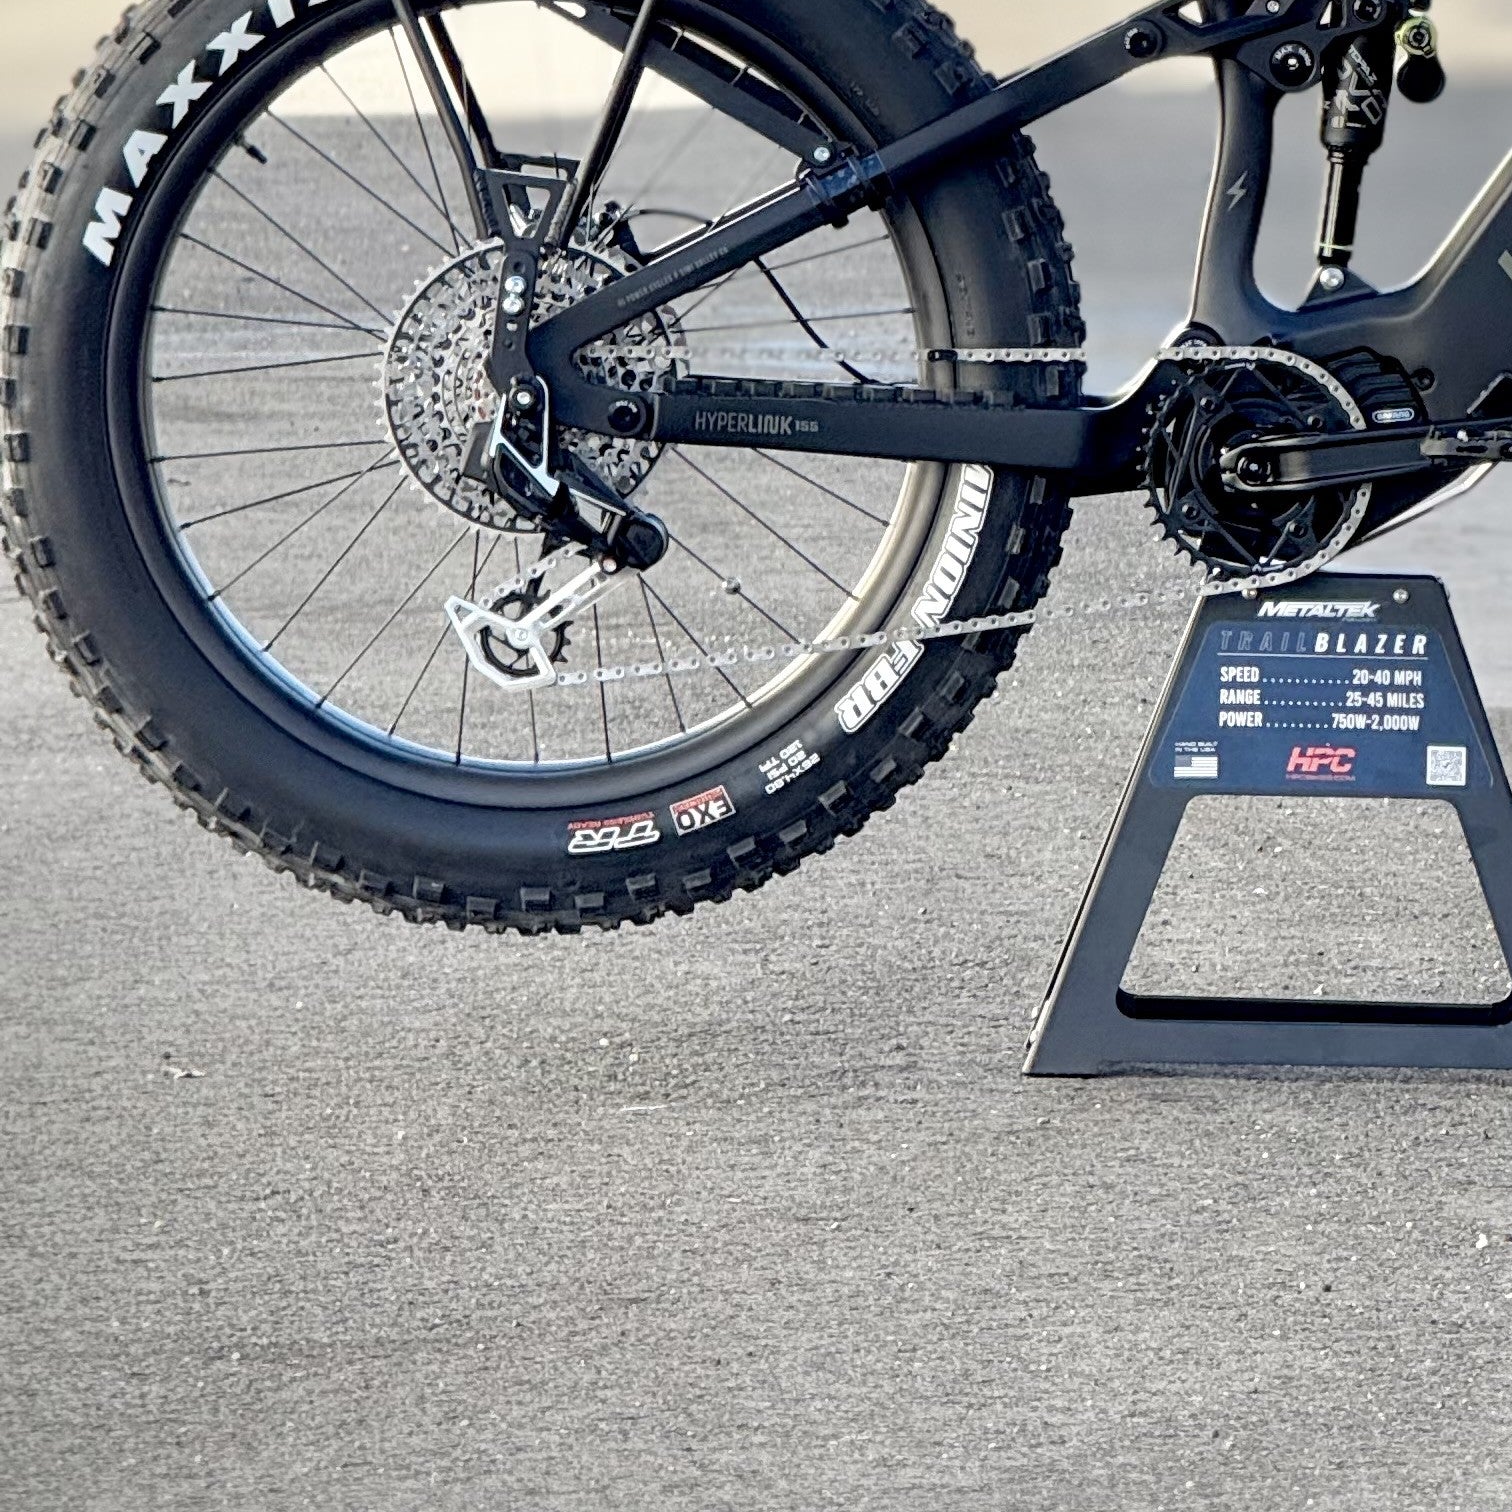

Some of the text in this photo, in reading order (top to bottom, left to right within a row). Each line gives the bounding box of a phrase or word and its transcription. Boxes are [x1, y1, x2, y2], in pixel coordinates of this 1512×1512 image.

[694, 410, 792, 436] HYPERLINK
[1257, 601, 1381, 618] METALTEK
[833, 639, 925, 735] FBR
[1219, 666, 1422, 686] SPEED 20-40 MPH
[1219, 688, 1424, 709] RANGE 25-45 MILES
[1218, 711, 1420, 731] POWER 750W-2,000W
[1286, 746, 1356, 773] HPC
[675, 795, 732, 832] EXO
[568, 818, 661, 854] TR
